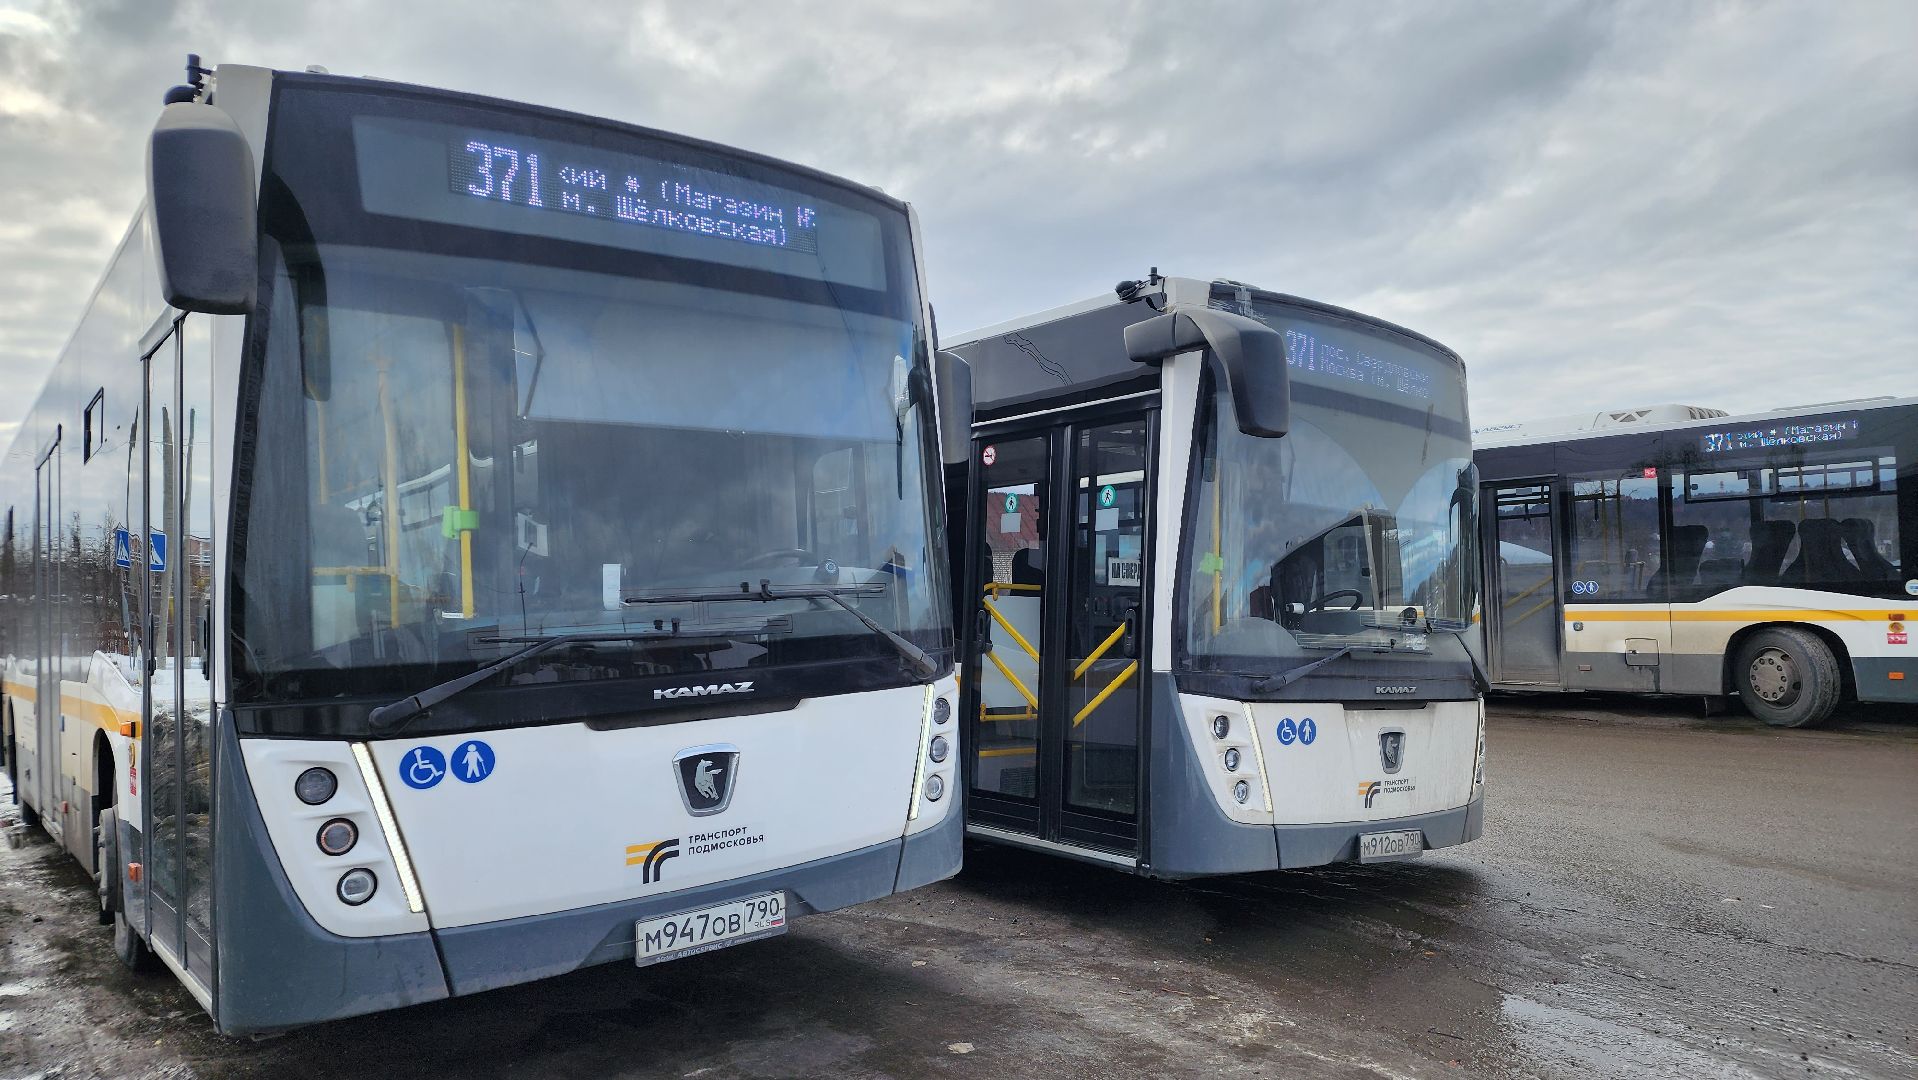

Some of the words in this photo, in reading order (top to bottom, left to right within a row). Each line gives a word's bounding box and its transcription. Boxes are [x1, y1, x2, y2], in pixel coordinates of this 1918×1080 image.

[466, 141, 543, 207] 371
[661, 180, 784, 223] (Магазин
[1286, 329, 1316, 371] 371
[1704, 432, 1733, 453] 371
[653, 681, 755, 700] KAMAZ
[1375, 686, 1417, 695] KAMAZ
[688, 826, 748, 844] ТРАНСПОРТ
[688, 834, 765, 856] ПОДМОСКОВЬЯ
[745, 897, 780, 923] 790
[677, 942, 723, 959] АВТОСЕРВИС
